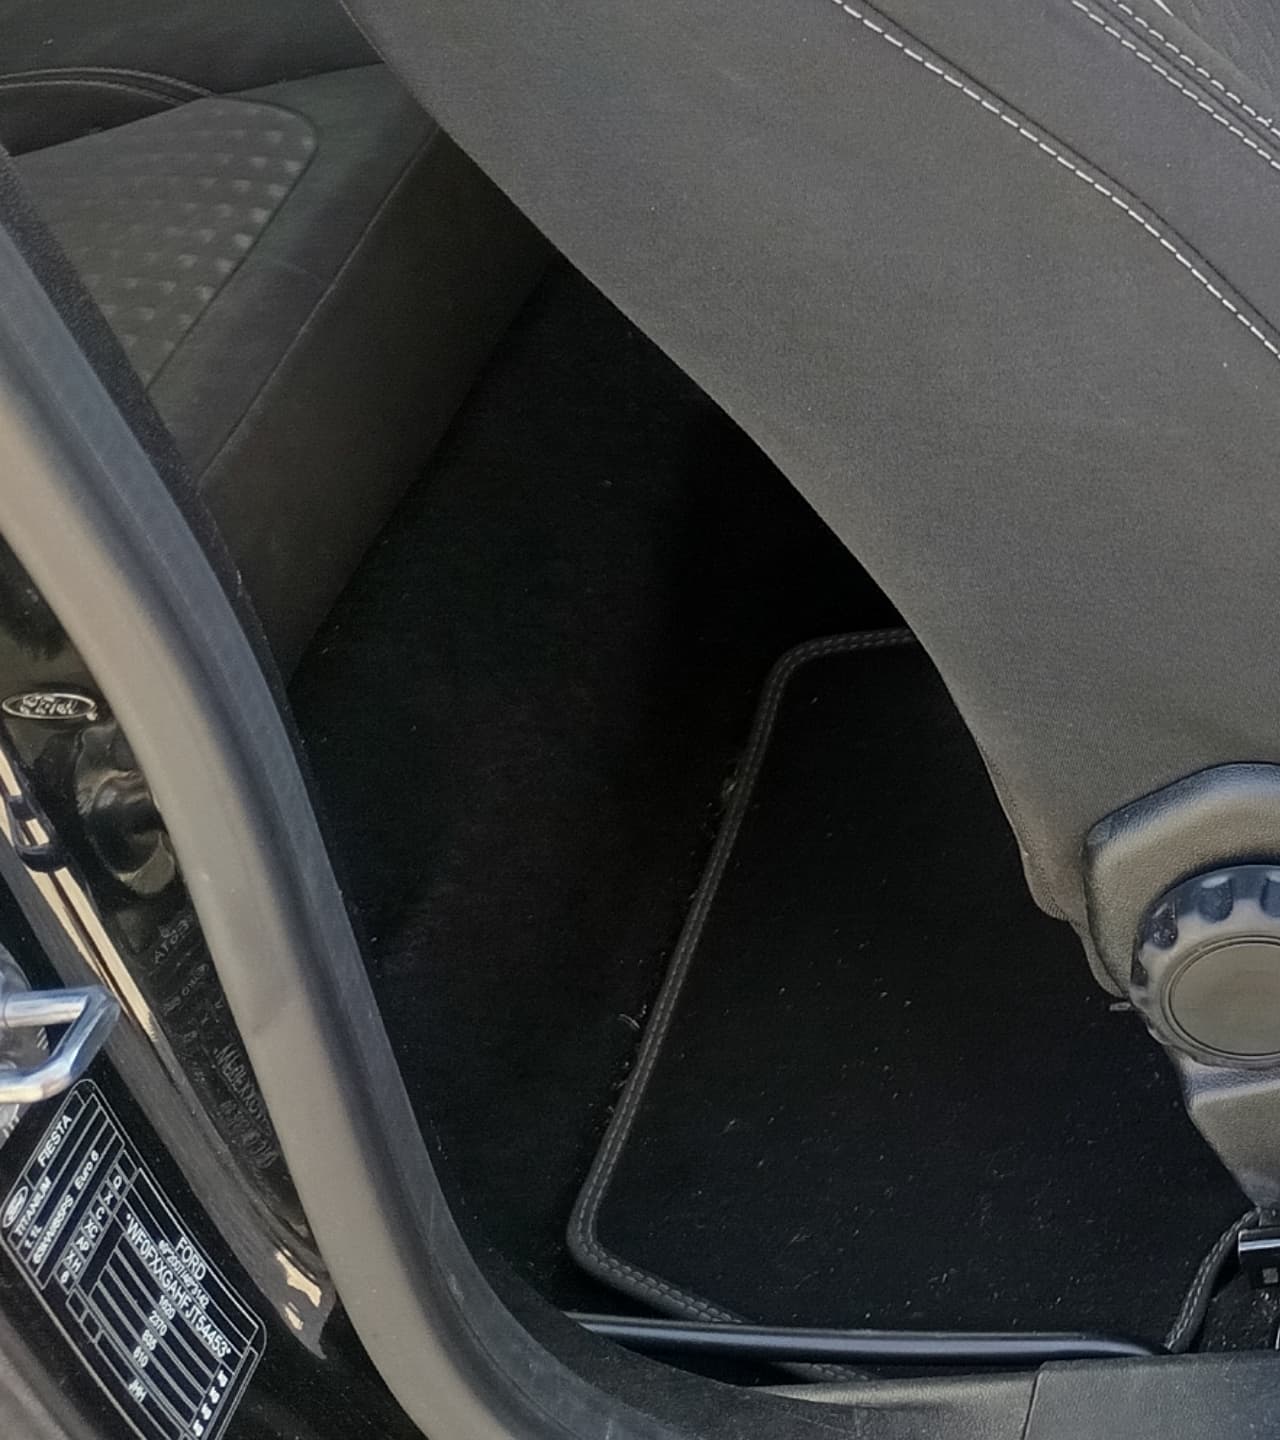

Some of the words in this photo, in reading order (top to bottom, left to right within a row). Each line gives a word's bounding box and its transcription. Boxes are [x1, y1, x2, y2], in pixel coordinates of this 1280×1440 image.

[38, 1115, 72, 1167] FIESTA
[75, 1162, 94, 1190] Euro
[91, 1150, 99, 1161] 6
[15, 1176, 51, 1236] TITANIUM
[96, 1206, 105, 1220] C
[104, 1191, 114, 1205] X
[84, 1219, 98, 1238] XC
[175, 1237, 206, 1281] FORD
